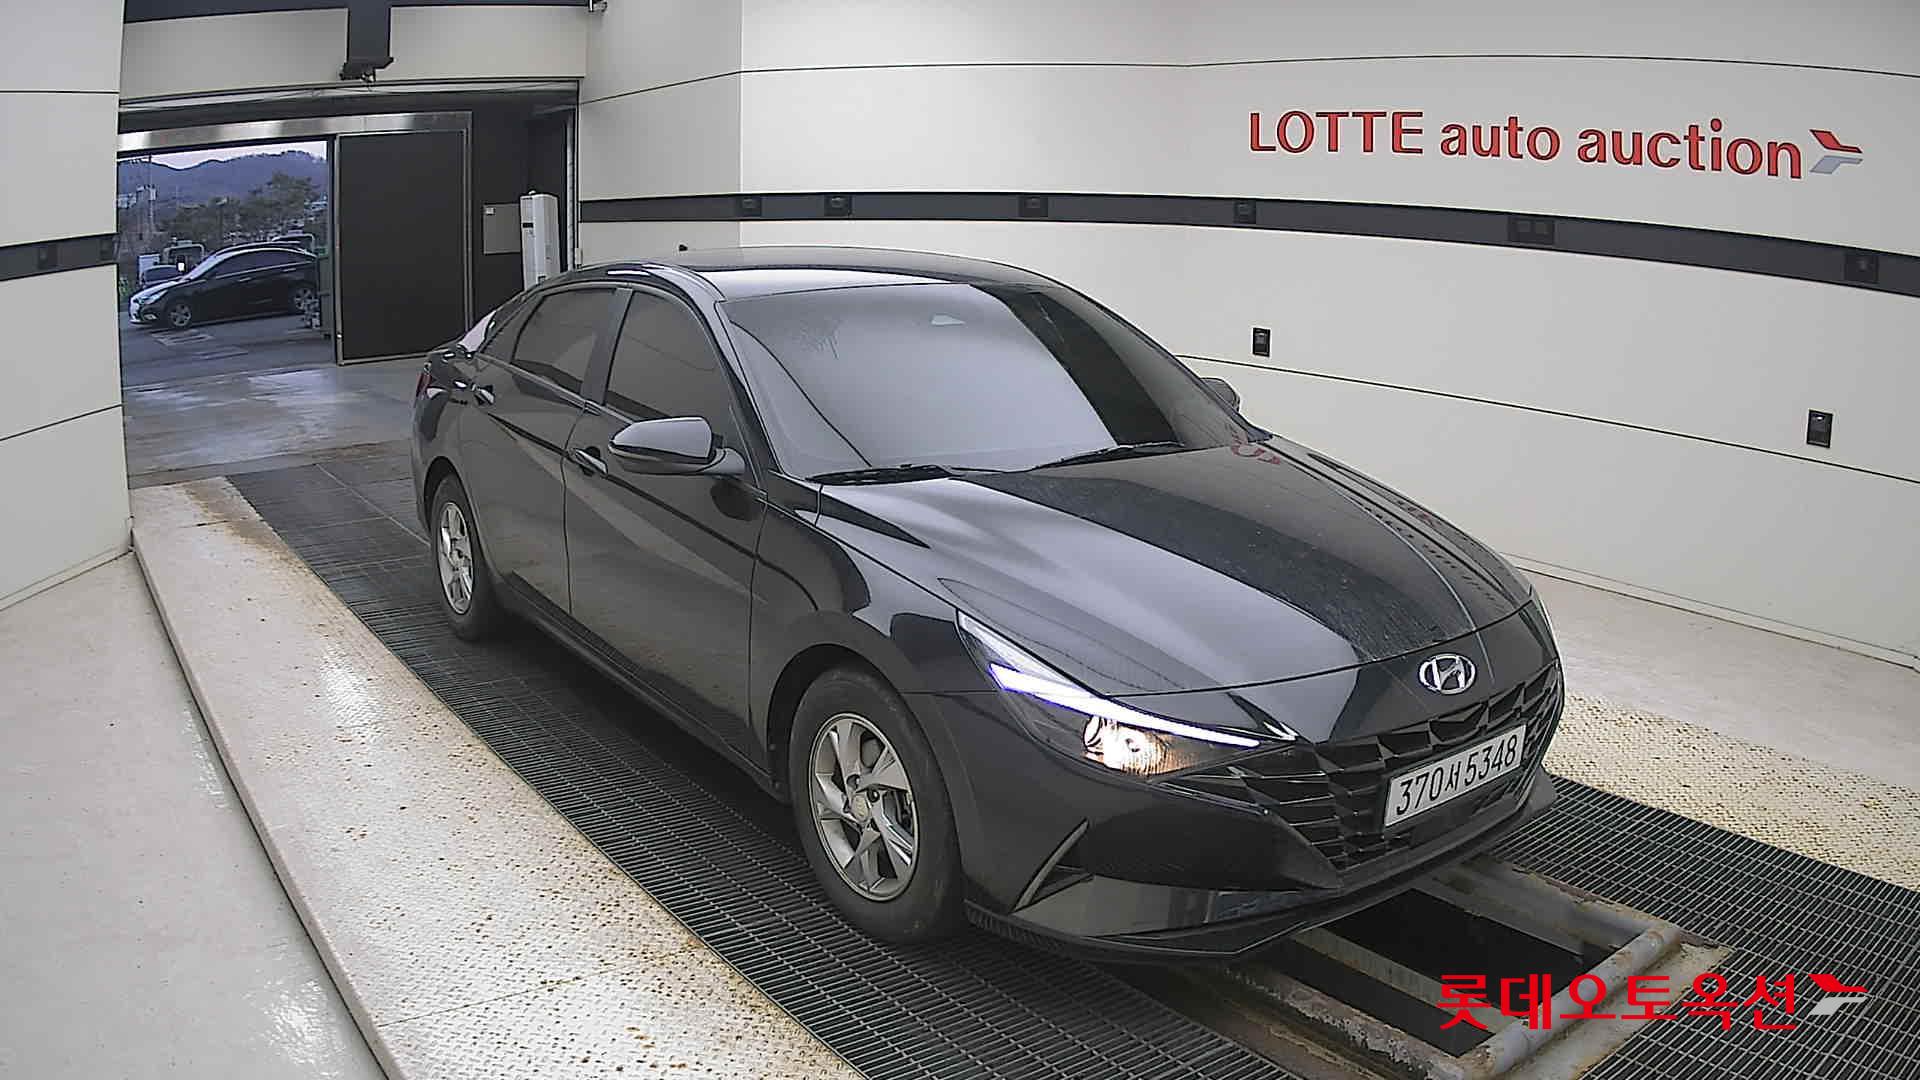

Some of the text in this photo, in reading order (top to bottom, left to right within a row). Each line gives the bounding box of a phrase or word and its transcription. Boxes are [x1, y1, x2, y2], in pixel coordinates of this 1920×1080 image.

[1249, 110, 1802, 179] LOTTE auto auction
[1464, 734, 1518, 787] 5348
